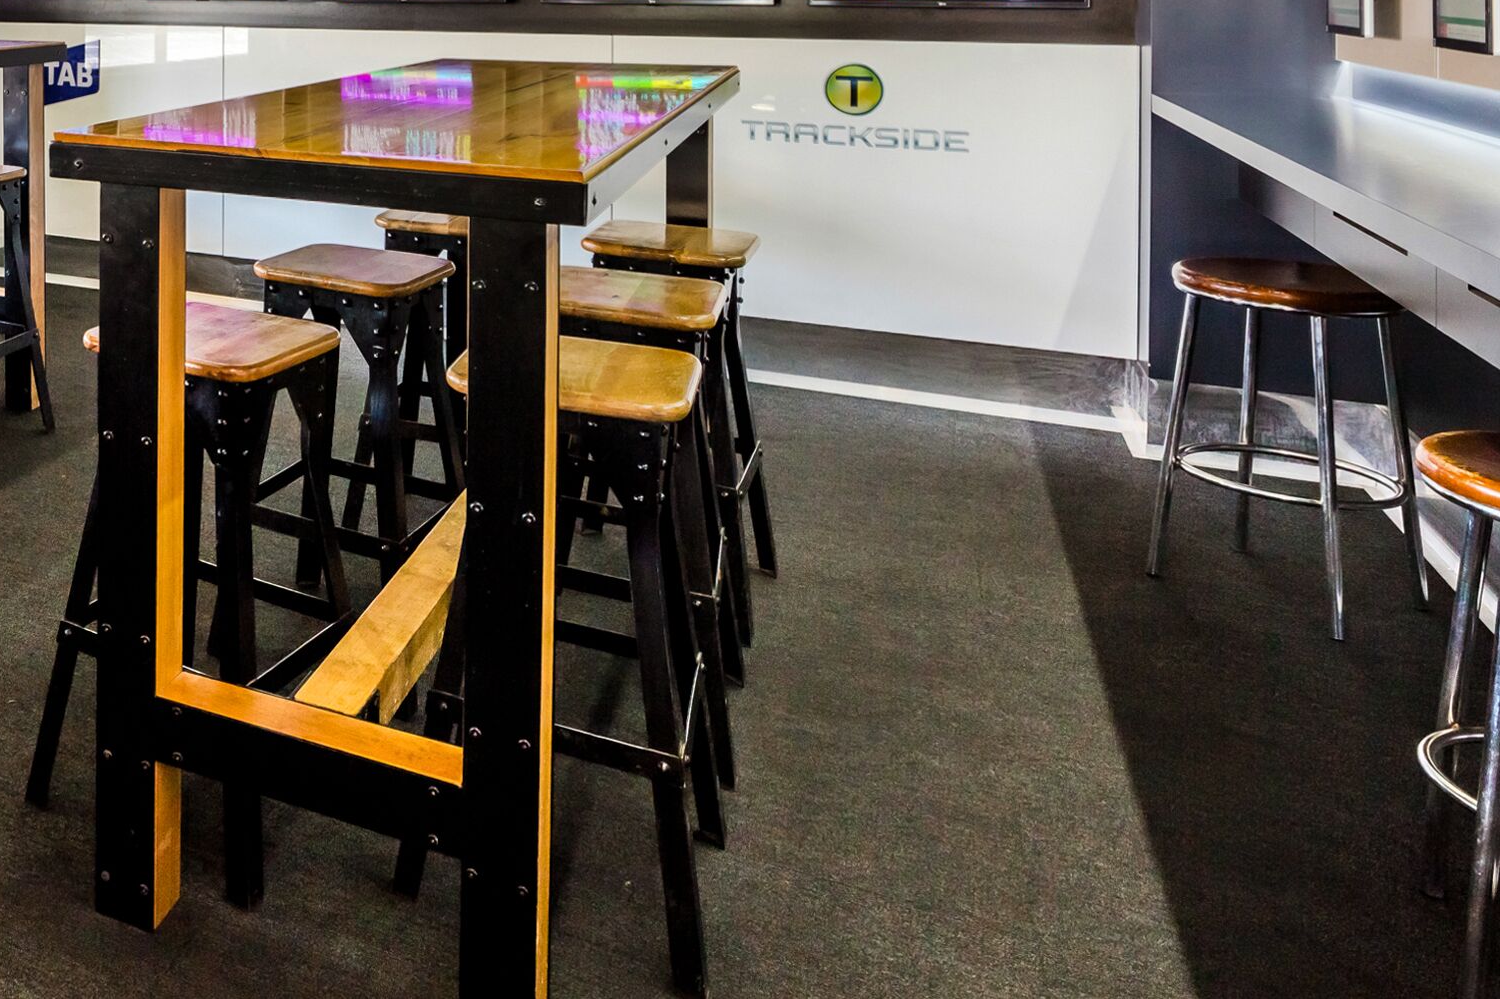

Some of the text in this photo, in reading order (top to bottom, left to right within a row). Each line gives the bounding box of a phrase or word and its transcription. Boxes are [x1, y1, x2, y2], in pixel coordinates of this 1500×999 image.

[43, 61, 93, 88] TAB
[836, 75, 873, 107] T
[741, 120, 970, 153] TRACKSIDE
